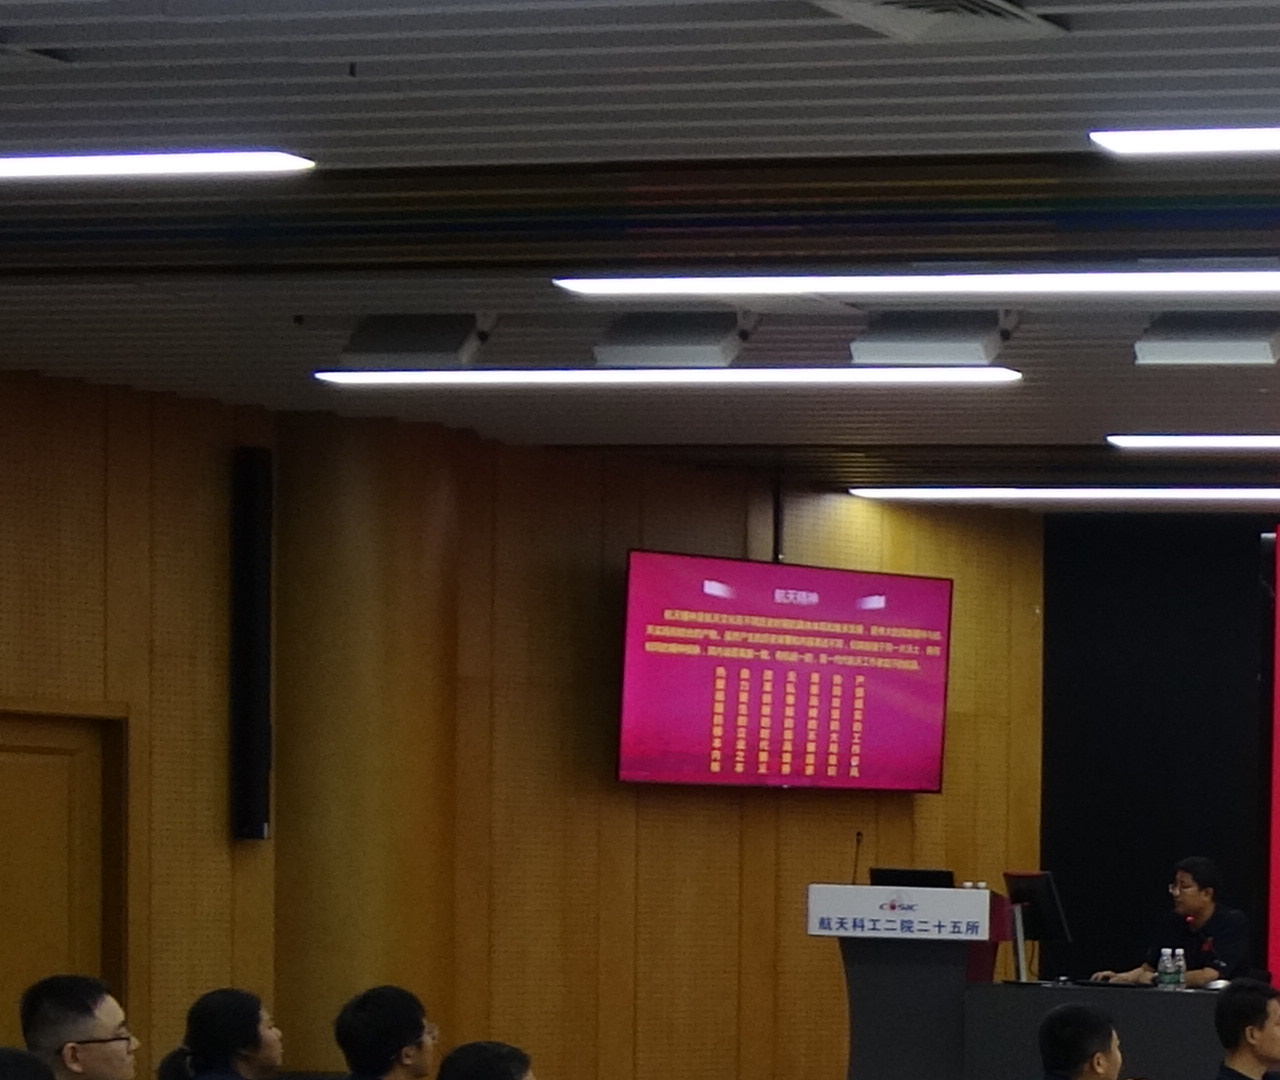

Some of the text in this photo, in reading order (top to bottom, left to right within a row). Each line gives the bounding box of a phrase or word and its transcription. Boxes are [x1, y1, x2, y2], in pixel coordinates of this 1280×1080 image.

[817, 916, 980, 936] 航天科工二院二十五所
